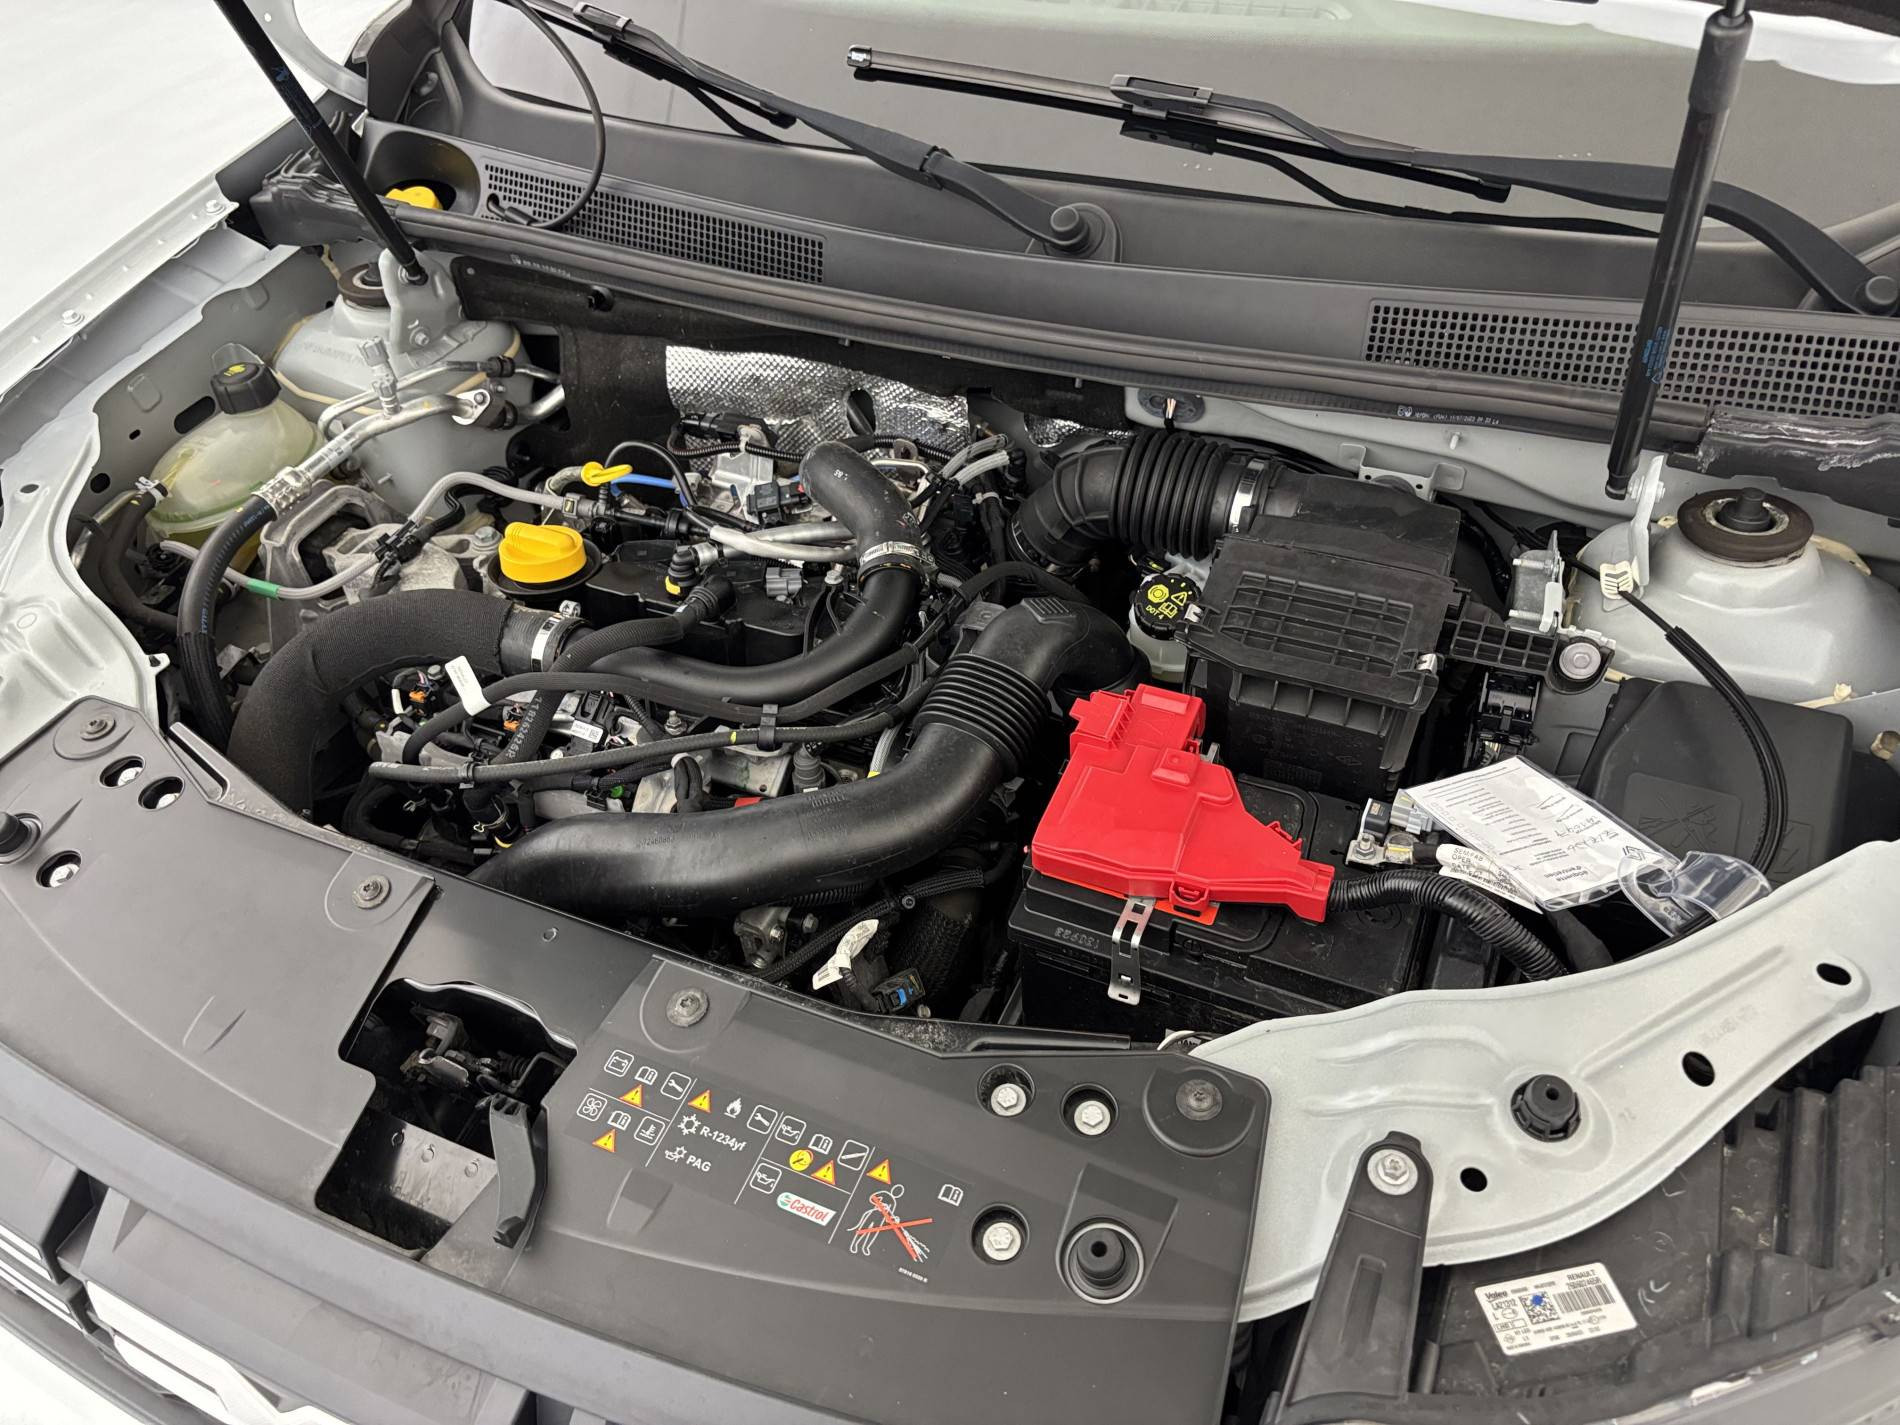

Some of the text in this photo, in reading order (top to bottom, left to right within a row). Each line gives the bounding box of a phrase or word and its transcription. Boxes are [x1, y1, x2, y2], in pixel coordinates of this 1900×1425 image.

[1146, 604, 1160, 616] DOT
[700, 1125, 747, 1152] R-1234yf
[686, 1154, 711, 1172] PAG
[790, 1199, 830, 1222] Castrol
[1566, 1268, 1596, 1281] RENAULT
